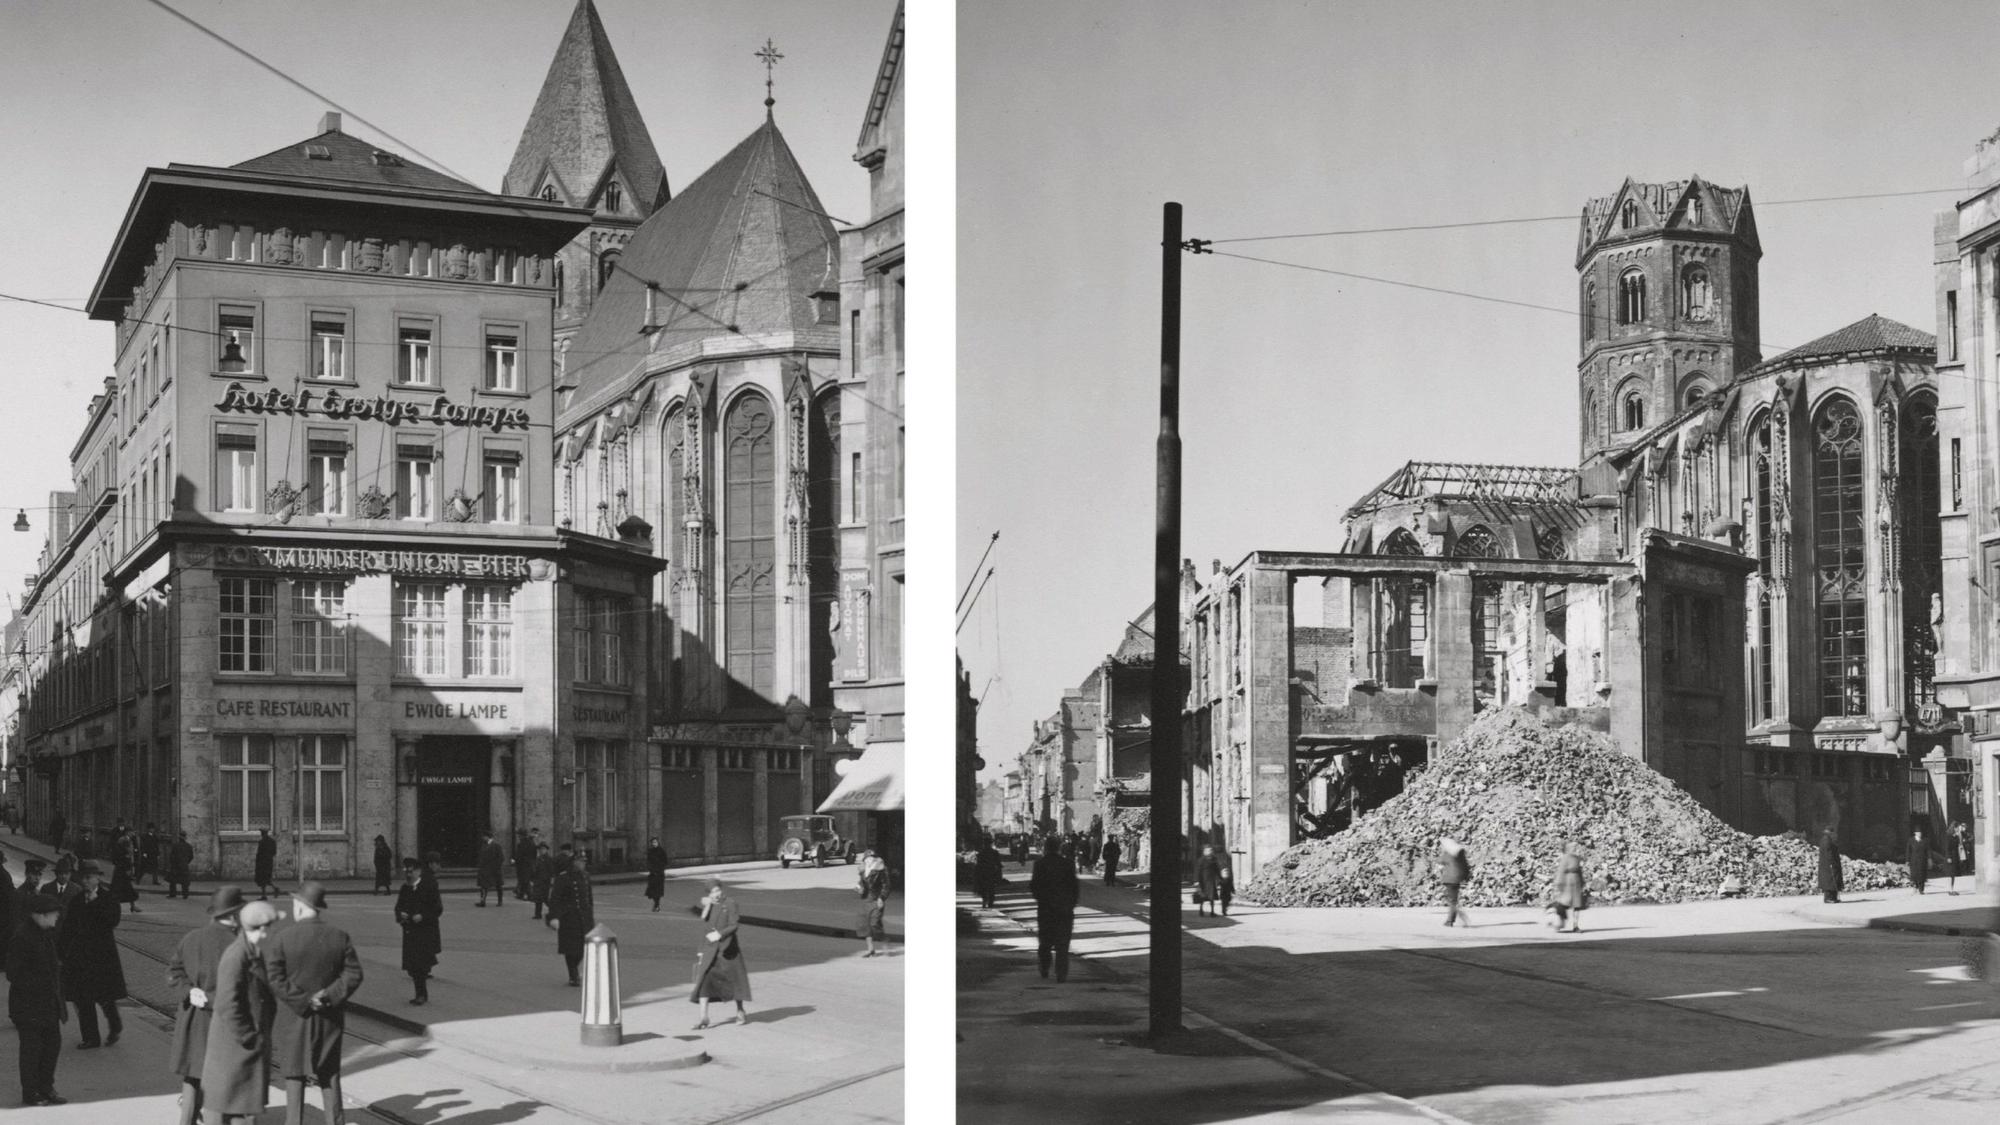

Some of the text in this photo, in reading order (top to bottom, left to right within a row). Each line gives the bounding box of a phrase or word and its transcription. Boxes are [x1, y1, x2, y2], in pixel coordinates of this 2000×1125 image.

[216, 380, 528, 430] Hotel Ewige Lampe
[843, 573, 866, 581] DOM
[260, 699, 351, 718] RESTAURANT
[405, 701, 508, 719] EWIGE LAMPE
[421, 776, 472, 784] EWIGE LAMPE
